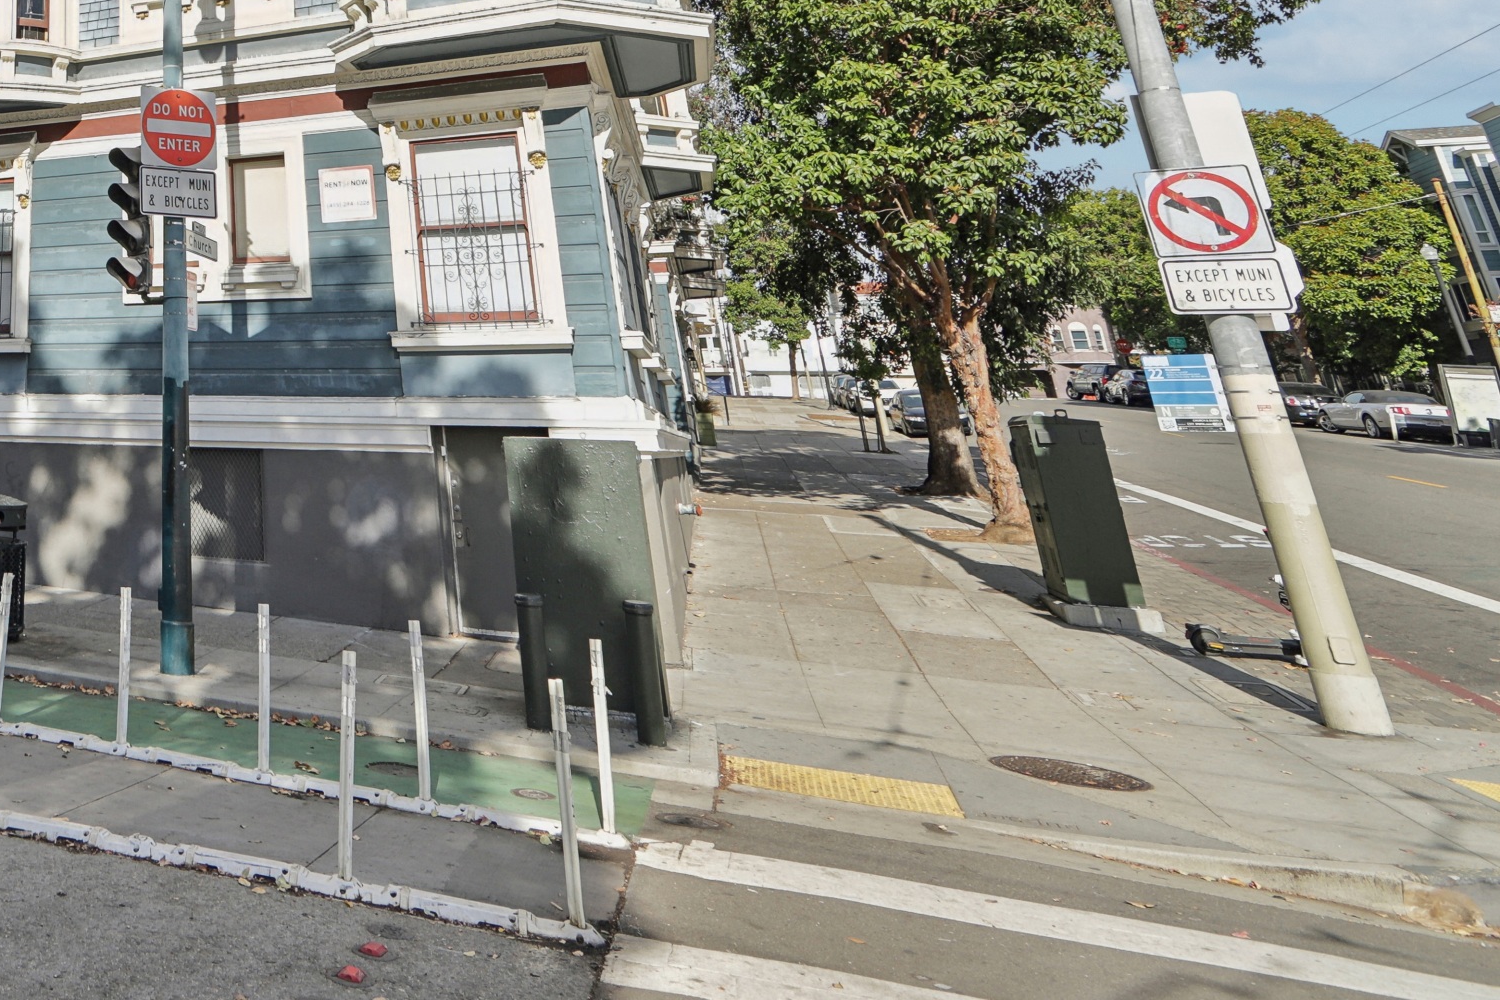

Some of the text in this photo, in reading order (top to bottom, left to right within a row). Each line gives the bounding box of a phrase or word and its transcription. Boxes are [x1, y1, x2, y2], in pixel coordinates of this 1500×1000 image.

[153, 102, 204, 119] DO NOT
[158, 137, 200, 153] ENTER
[145, 174, 211, 192] EXCEPT MUNI
[148, 194, 209, 211] & BICYCLES
[188, 234, 212, 255] Church
[1175, 268, 1273, 283] EXCEPT MUNI
[1185, 287, 1276, 303] & BICYCLES
[1148, 369, 1165, 380] 22
[1161, 406, 1173, 417] N
